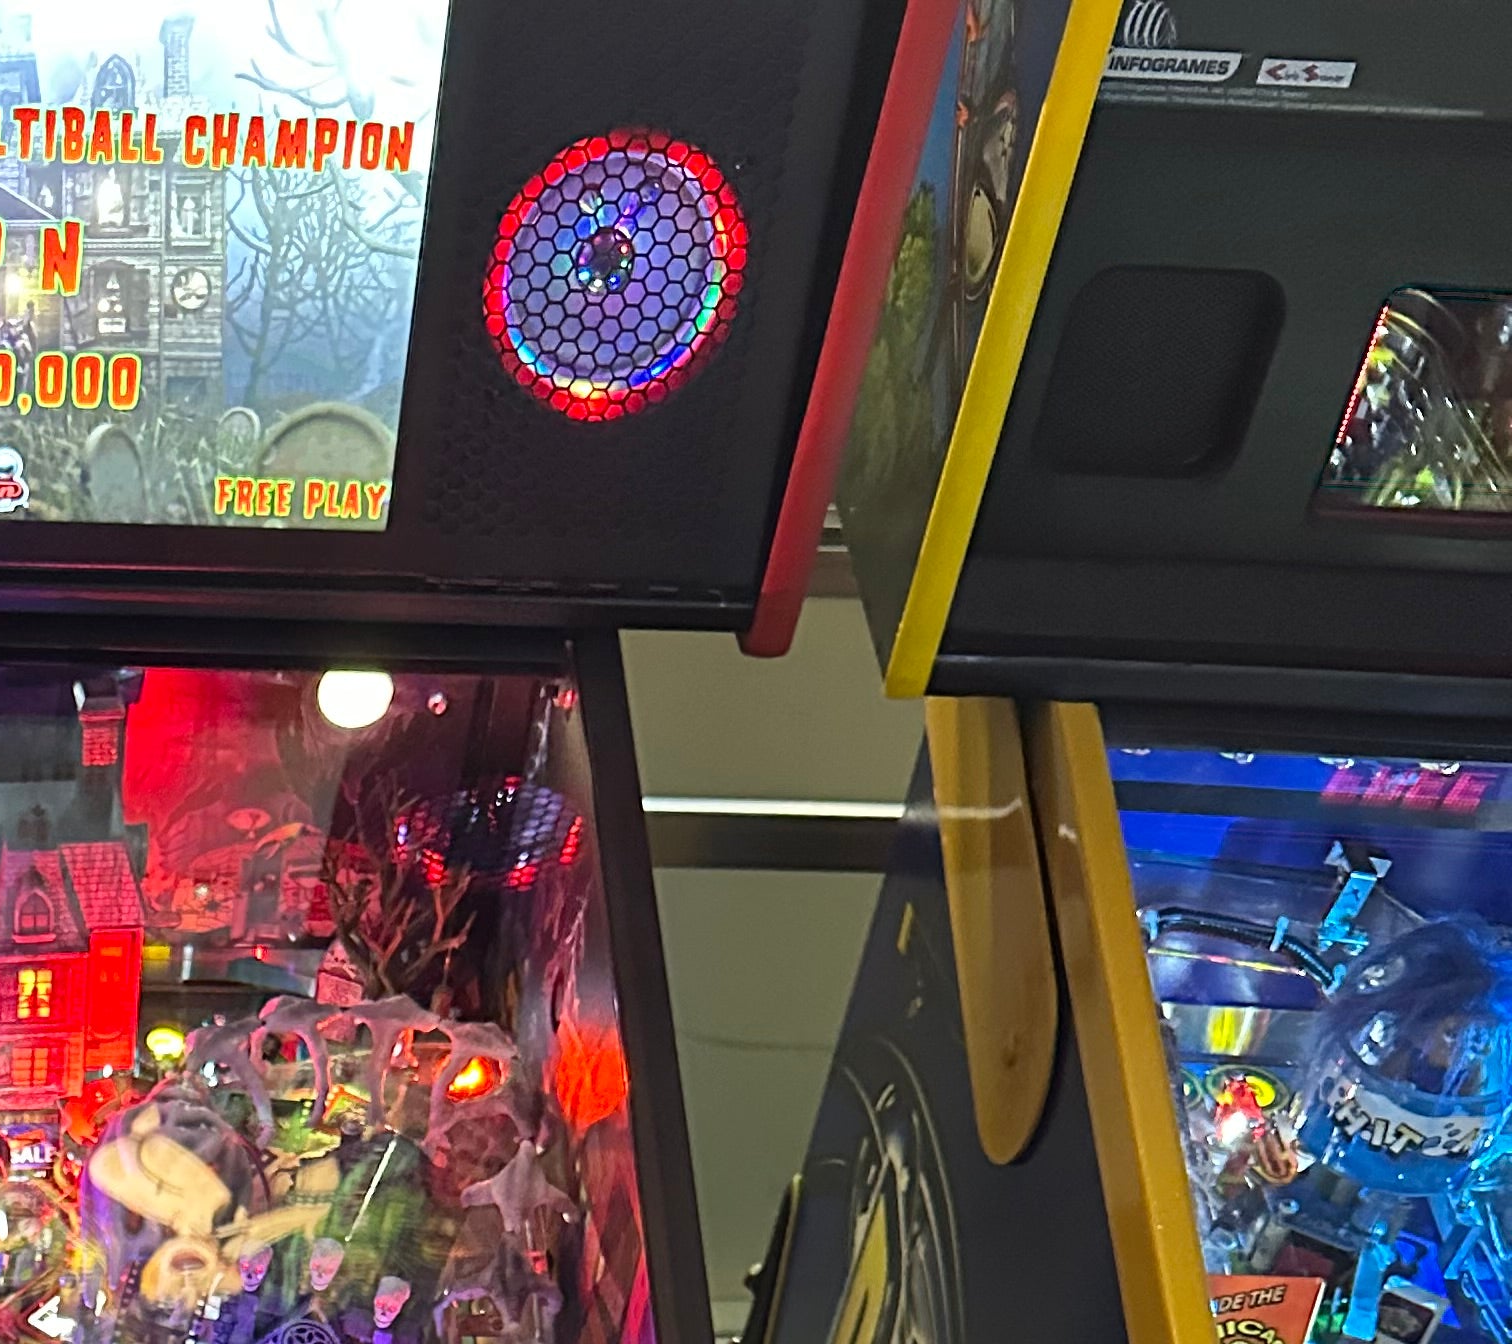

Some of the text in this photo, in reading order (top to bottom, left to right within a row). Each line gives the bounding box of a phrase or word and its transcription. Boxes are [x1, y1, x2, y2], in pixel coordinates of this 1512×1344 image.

[1109, 55, 1230, 76] INFOGRAMES
[183, 115, 416, 174] CHAMPION
[39, 218, 85, 297] N
[214, 478, 387, 520] FREE PLAY
[1248, 1284, 1287, 1308] THE
